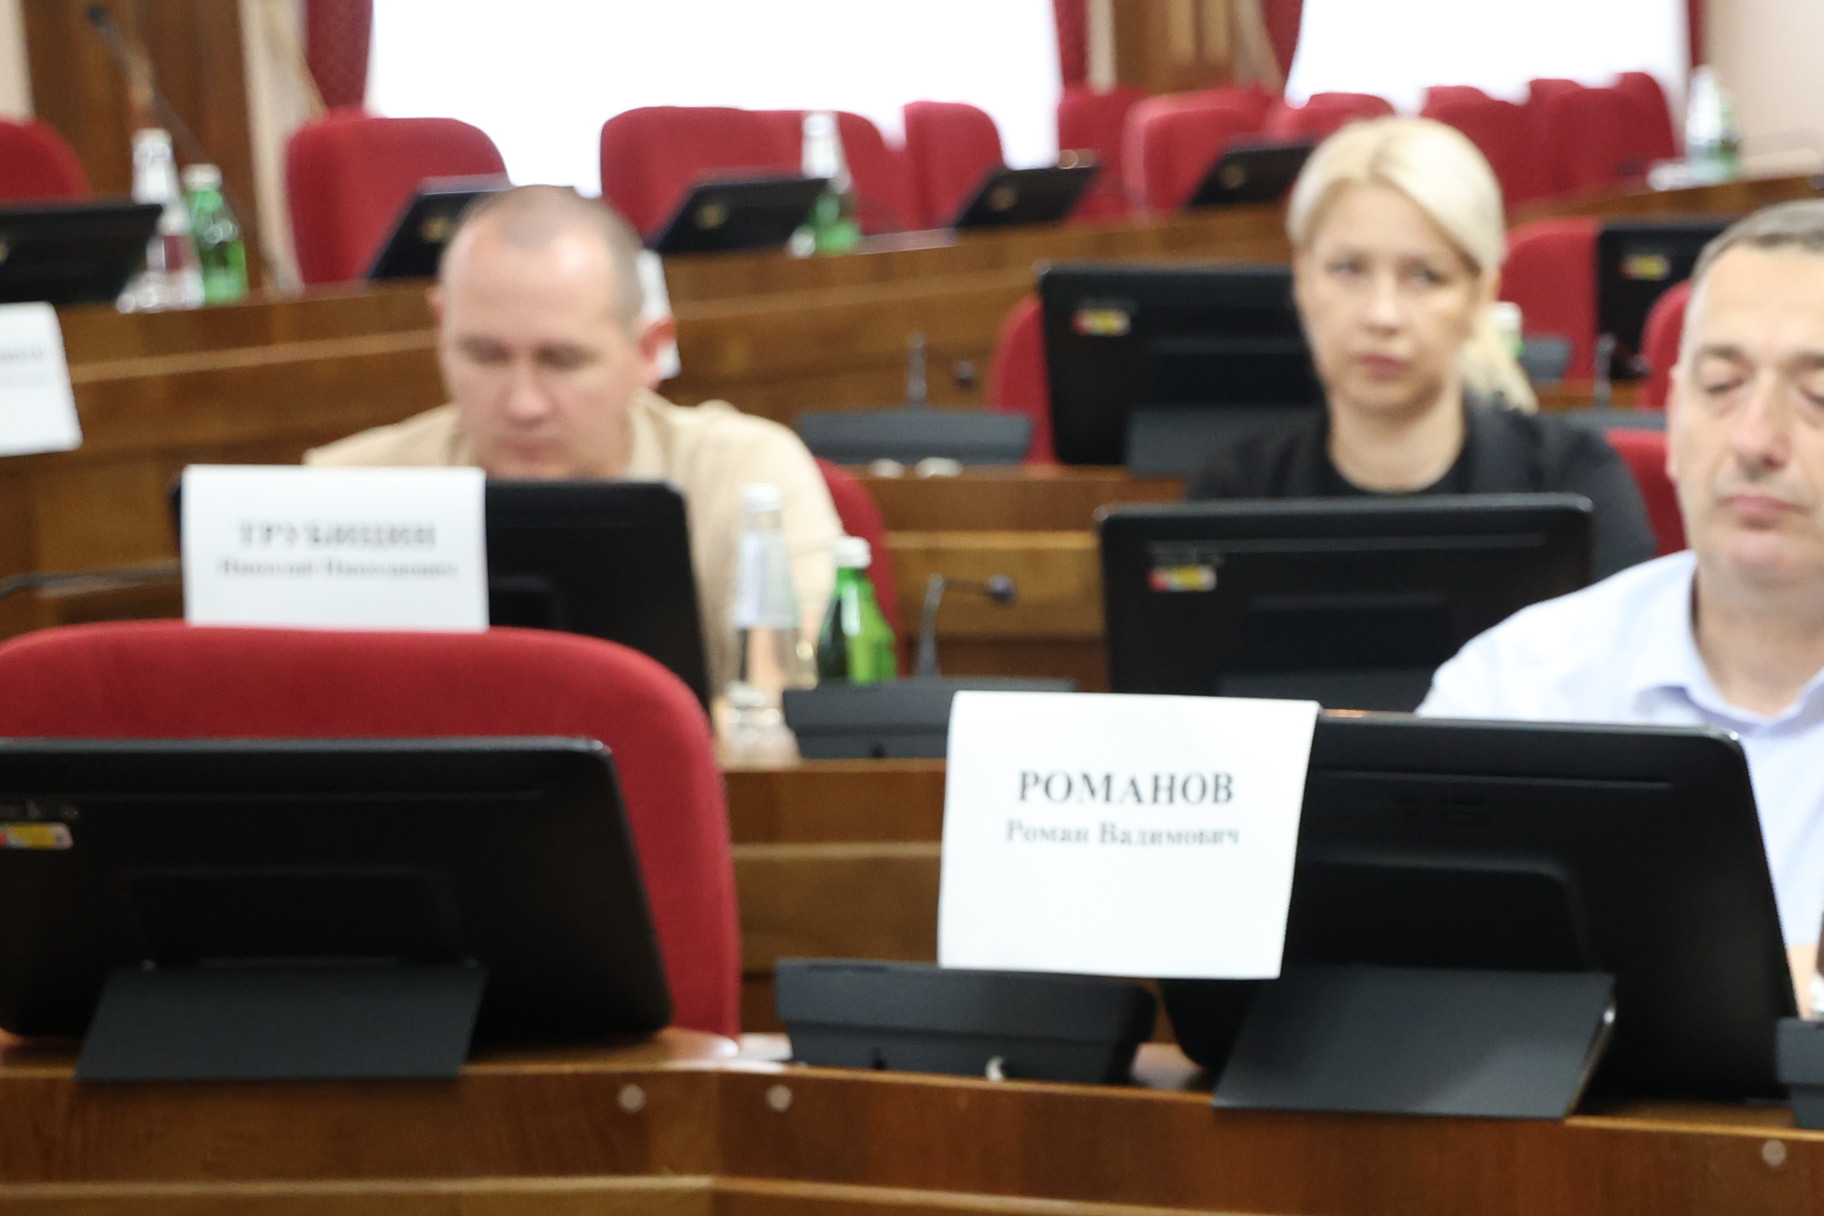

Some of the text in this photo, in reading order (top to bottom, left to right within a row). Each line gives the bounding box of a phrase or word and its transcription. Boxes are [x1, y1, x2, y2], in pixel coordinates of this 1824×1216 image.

[1017, 770, 1235, 805] РОМАНОВ
[1005, 819, 1240, 847] Роман Вадимович
